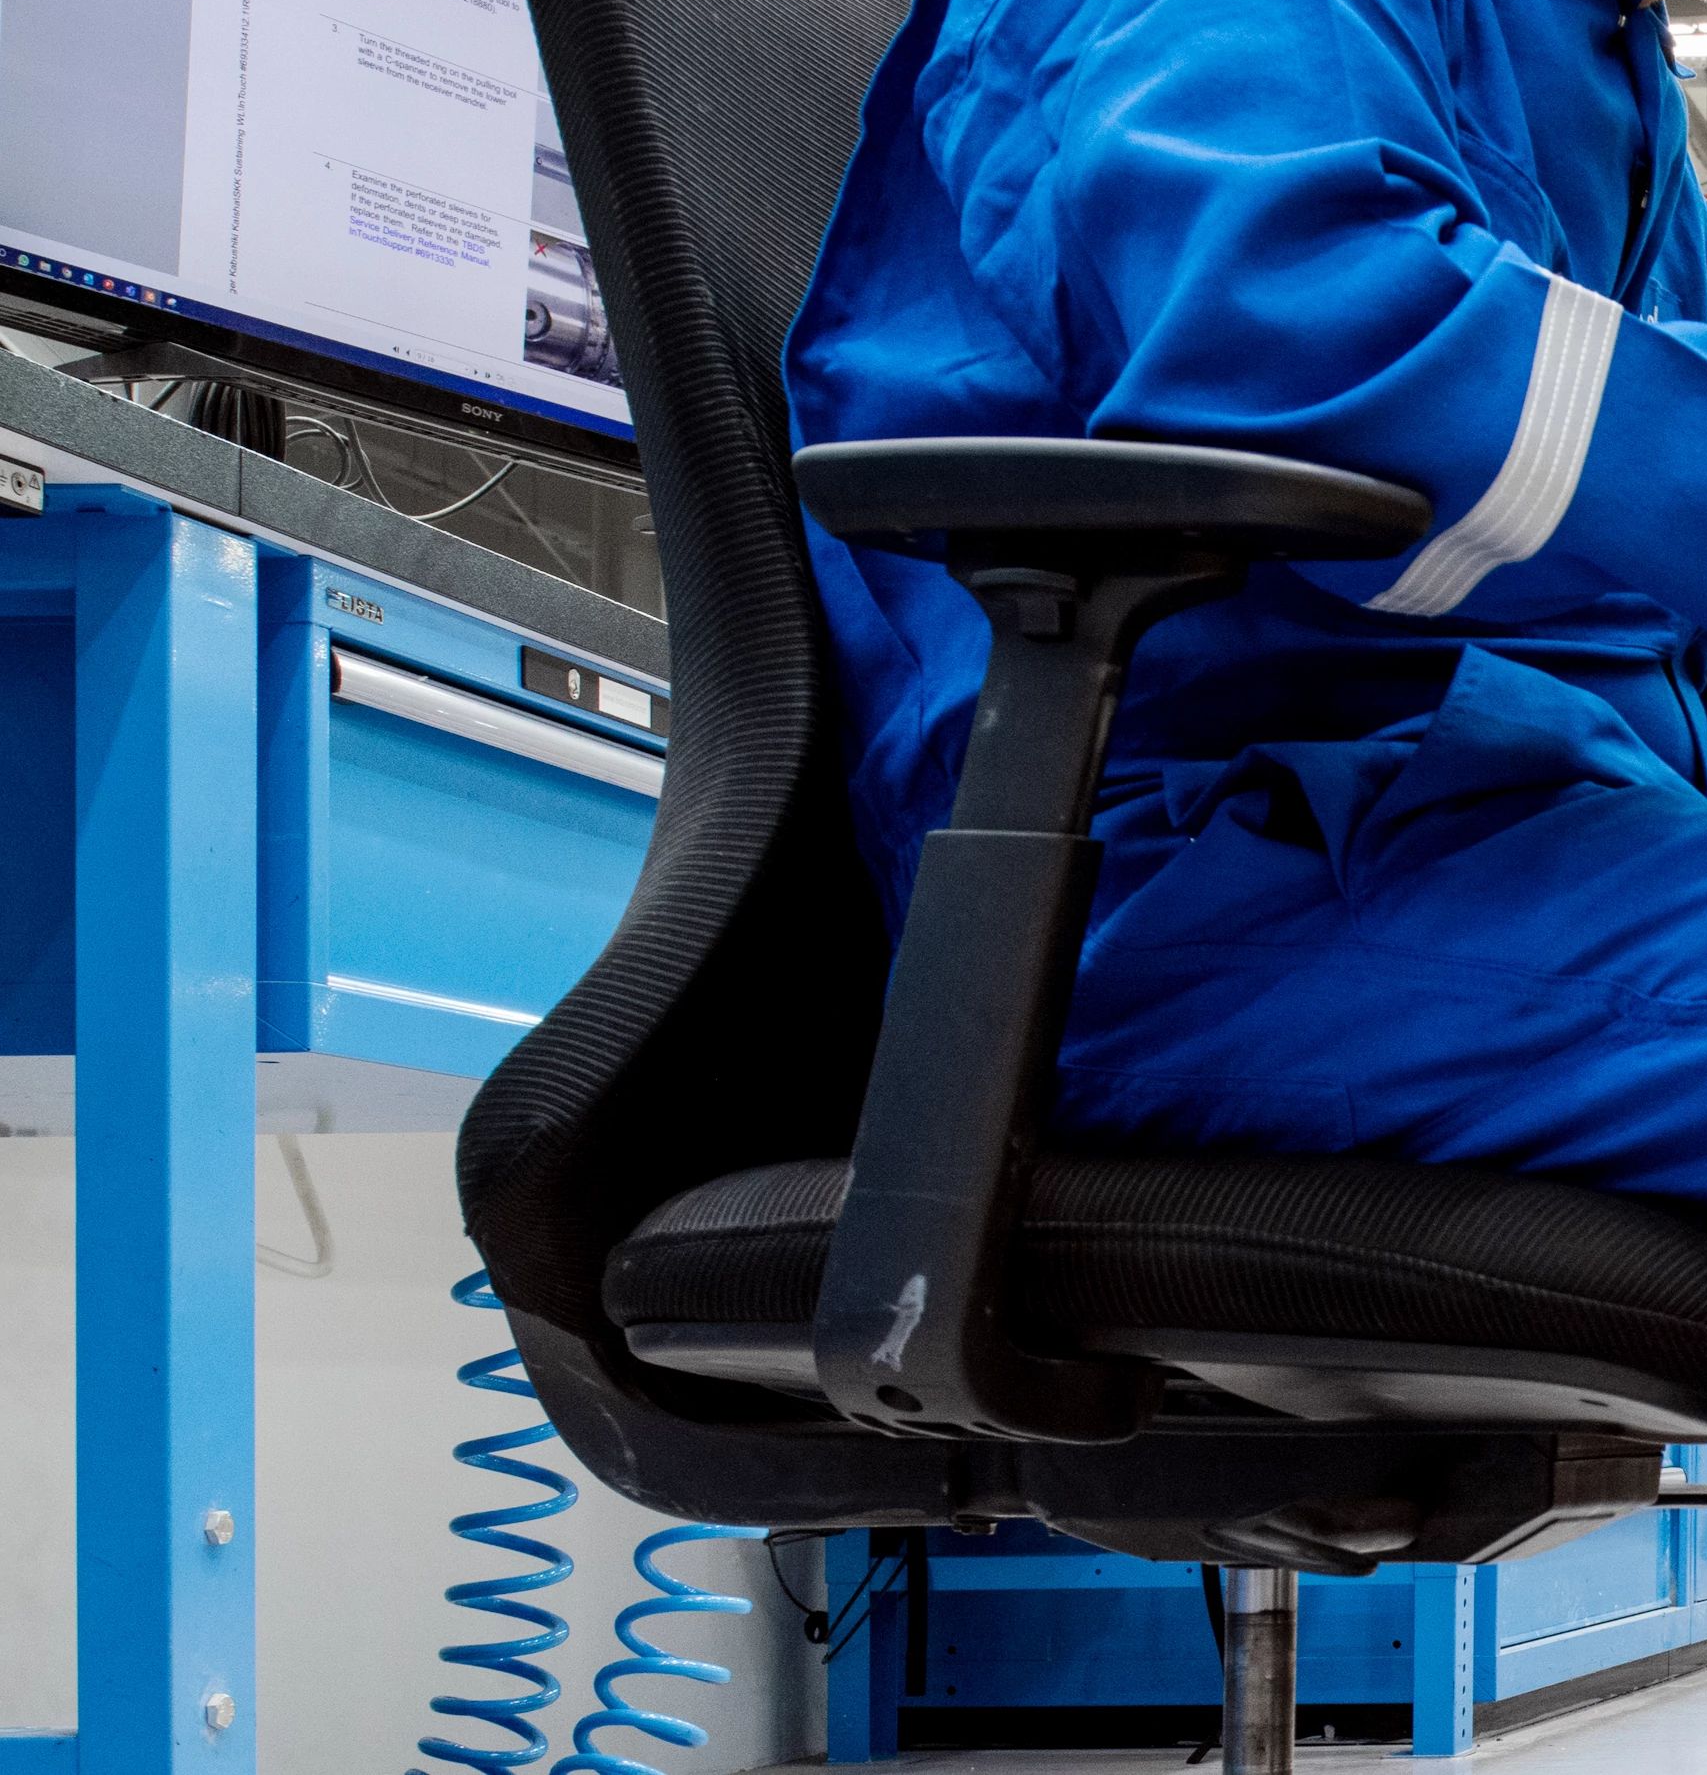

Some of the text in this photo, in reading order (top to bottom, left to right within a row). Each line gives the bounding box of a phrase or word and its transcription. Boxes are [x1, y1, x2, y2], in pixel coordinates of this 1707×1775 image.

[511, 1, 519, 11] to
[357, 57, 384, 72] sleeve
[386, 66, 404, 80] from
[406, 74, 419, 85] the
[421, 81, 452, 97] receiver
[358, 46, 374, 57] with
[384, 54, 427, 76] C-spanner
[429, 71, 437, 80] to
[439, 76, 468, 92] remove
[470, 86, 483, 97] the
[485, 91, 506, 105] lower
[359, 32, 516, 98] Turn the threaded ring on the pulling tool
[228, 232, 238, 277] Kabushiki
[233, 127, 245, 177] Sustaining
[351, 169, 491, 222] Examine the perforated sleeves for
[358, 195, 371, 206] the
[373, 201, 415, 220] perforated
[417, 215, 447, 231] sleeves
[449, 226, 462, 236] are
[404, 199, 426, 213] dents
[439, 211, 458, 225] deep
[349, 205, 380, 220] replace
[411, 223, 433, 237] Refer
[435, 231, 443, 241] to
[446, 235, 458, 245] the
[462, 239, 484, 254] TBDS
[349, 215, 380, 232] Service
[382, 225, 415, 244] Delivery
[417, 236, 458, 257] Reference
[461, 403, 502, 422] SONY
[341, 595, 383, 622] LISTA
